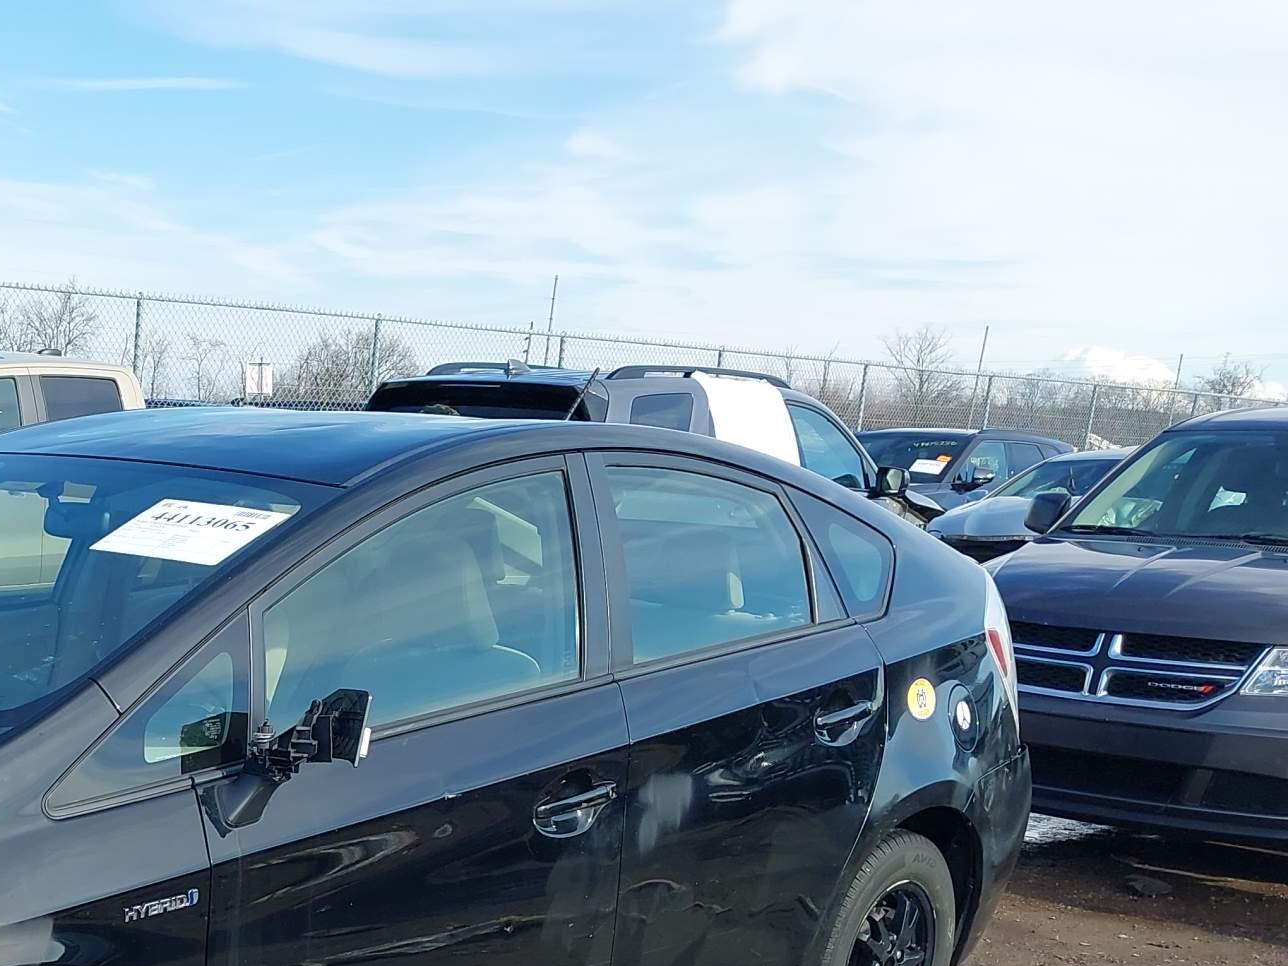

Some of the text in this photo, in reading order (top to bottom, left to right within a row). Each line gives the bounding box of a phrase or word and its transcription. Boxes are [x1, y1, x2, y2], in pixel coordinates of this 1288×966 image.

[151, 511, 257, 532] 44113065
[1147, 681, 1203, 692] DODGE
[123, 894, 188, 923] HYBRID
